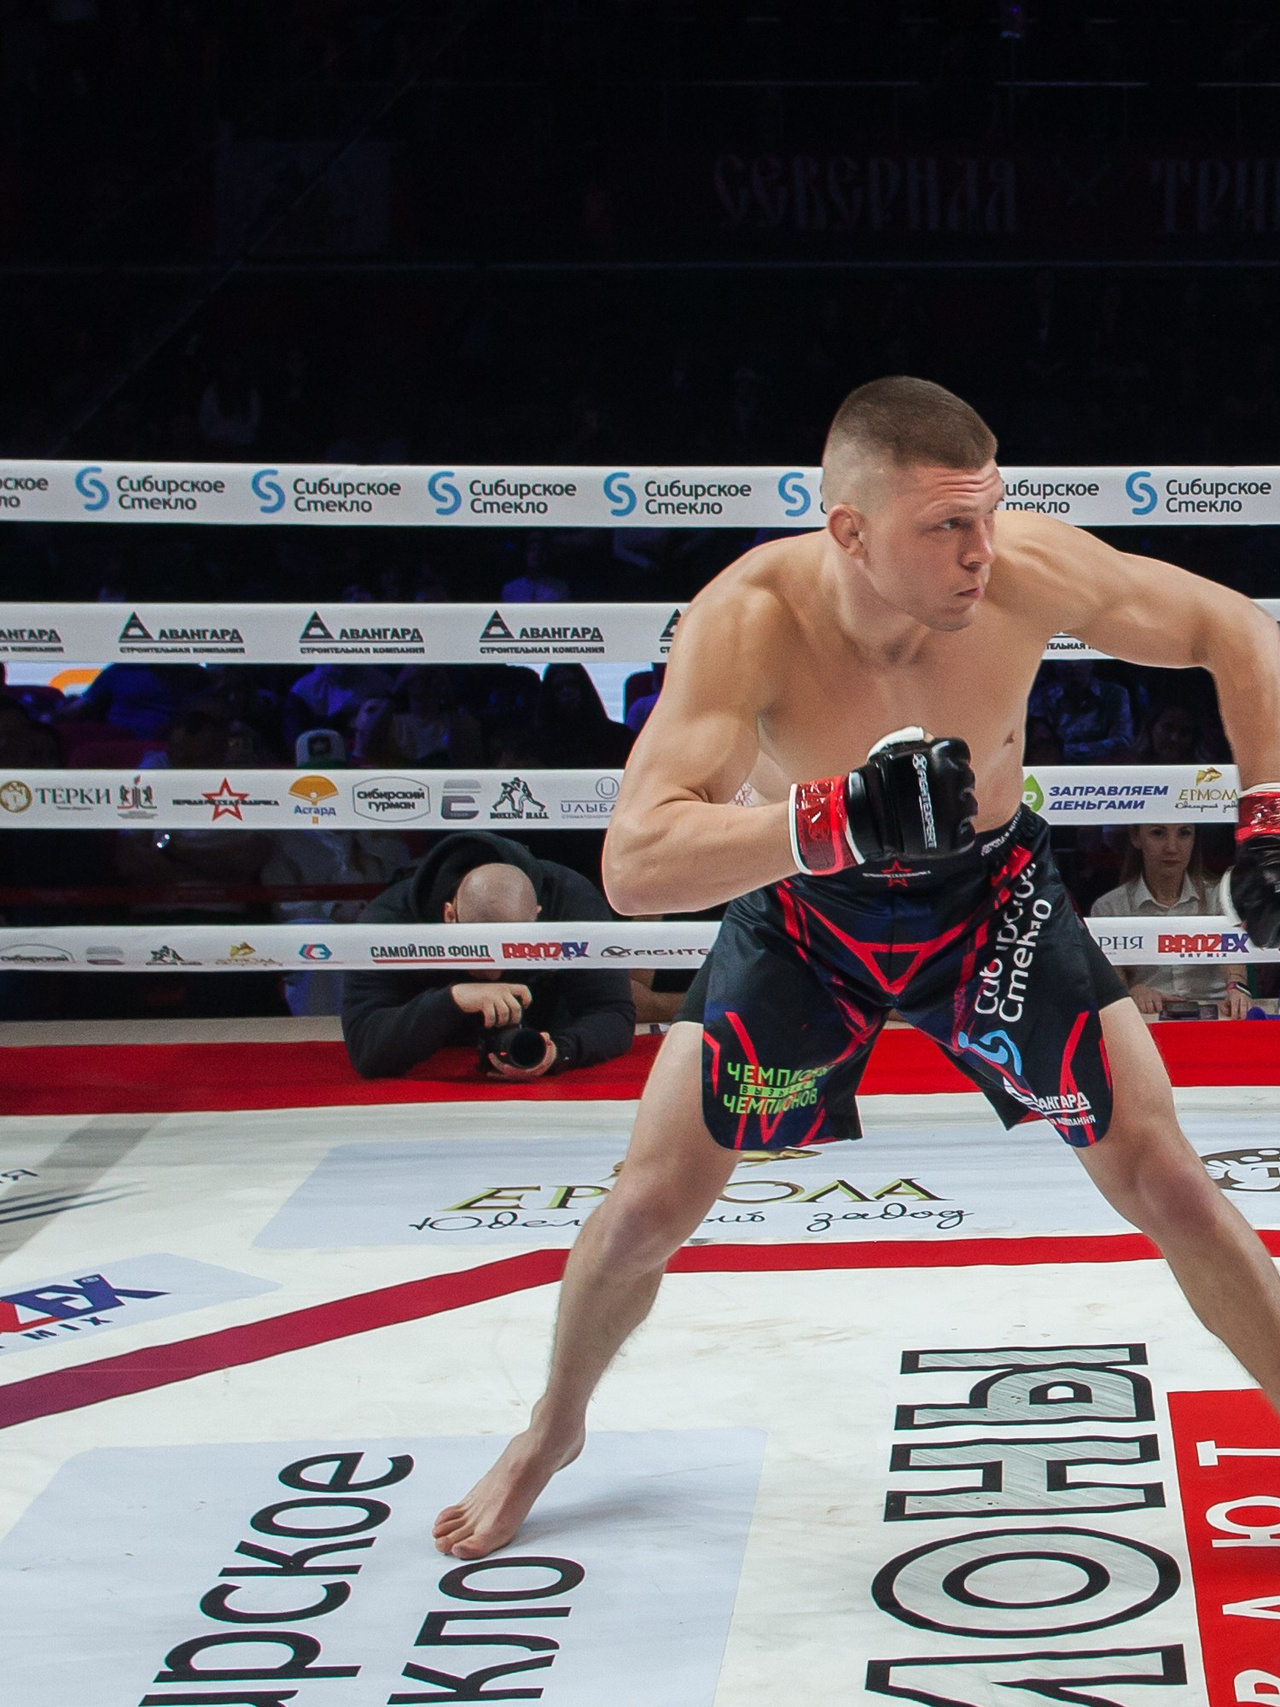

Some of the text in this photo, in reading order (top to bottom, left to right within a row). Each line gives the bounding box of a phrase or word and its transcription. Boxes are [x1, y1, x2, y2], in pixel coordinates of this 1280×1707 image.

[117, 475, 226, 493] Сибирское
[293, 478, 402, 497] Сибирское
[469, 479, 578, 498] Сибирское
[645, 480, 752, 498] Сибирское
[1004, 480, 1100, 498] ибирское
[1166, 479, 1272, 497] Сибирское
[118, 494, 198, 511] Стекло
[294, 497, 373, 513] Стекло
[470, 498, 549, 515] Стекло
[645, 499, 723, 515] Стекло
[1003, 499, 1071, 514] текло
[1166, 497, 1243, 513] Стекло
[0, 628, 61, 643] АНГАРД
[159, 628, 244, 643] АВАНГАРД
[340, 628, 424, 643] АВАНГАРД
[520, 627, 604, 642] АВАНГАРД
[480, 646, 605, 654] СТРОИТЕЛЬНАЯ КОМПАНИЯ
[357, 787, 425, 801] сибирский
[1049, 785, 1169, 796] ЗАПРАВЛЯЕМ
[294, 804, 337, 817] Асгард
[368, 800, 416, 811] гурман
[1048, 800, 1146, 811] ДЕНЬГАМИ
[371, 943, 491, 958] САМОЙЛОВ ФОНД
[1158, 933, 1250, 953] BROZEX
[440, 1178, 955, 1210] ЕРОЛА
[811, 1202, 975, 1232] завод
